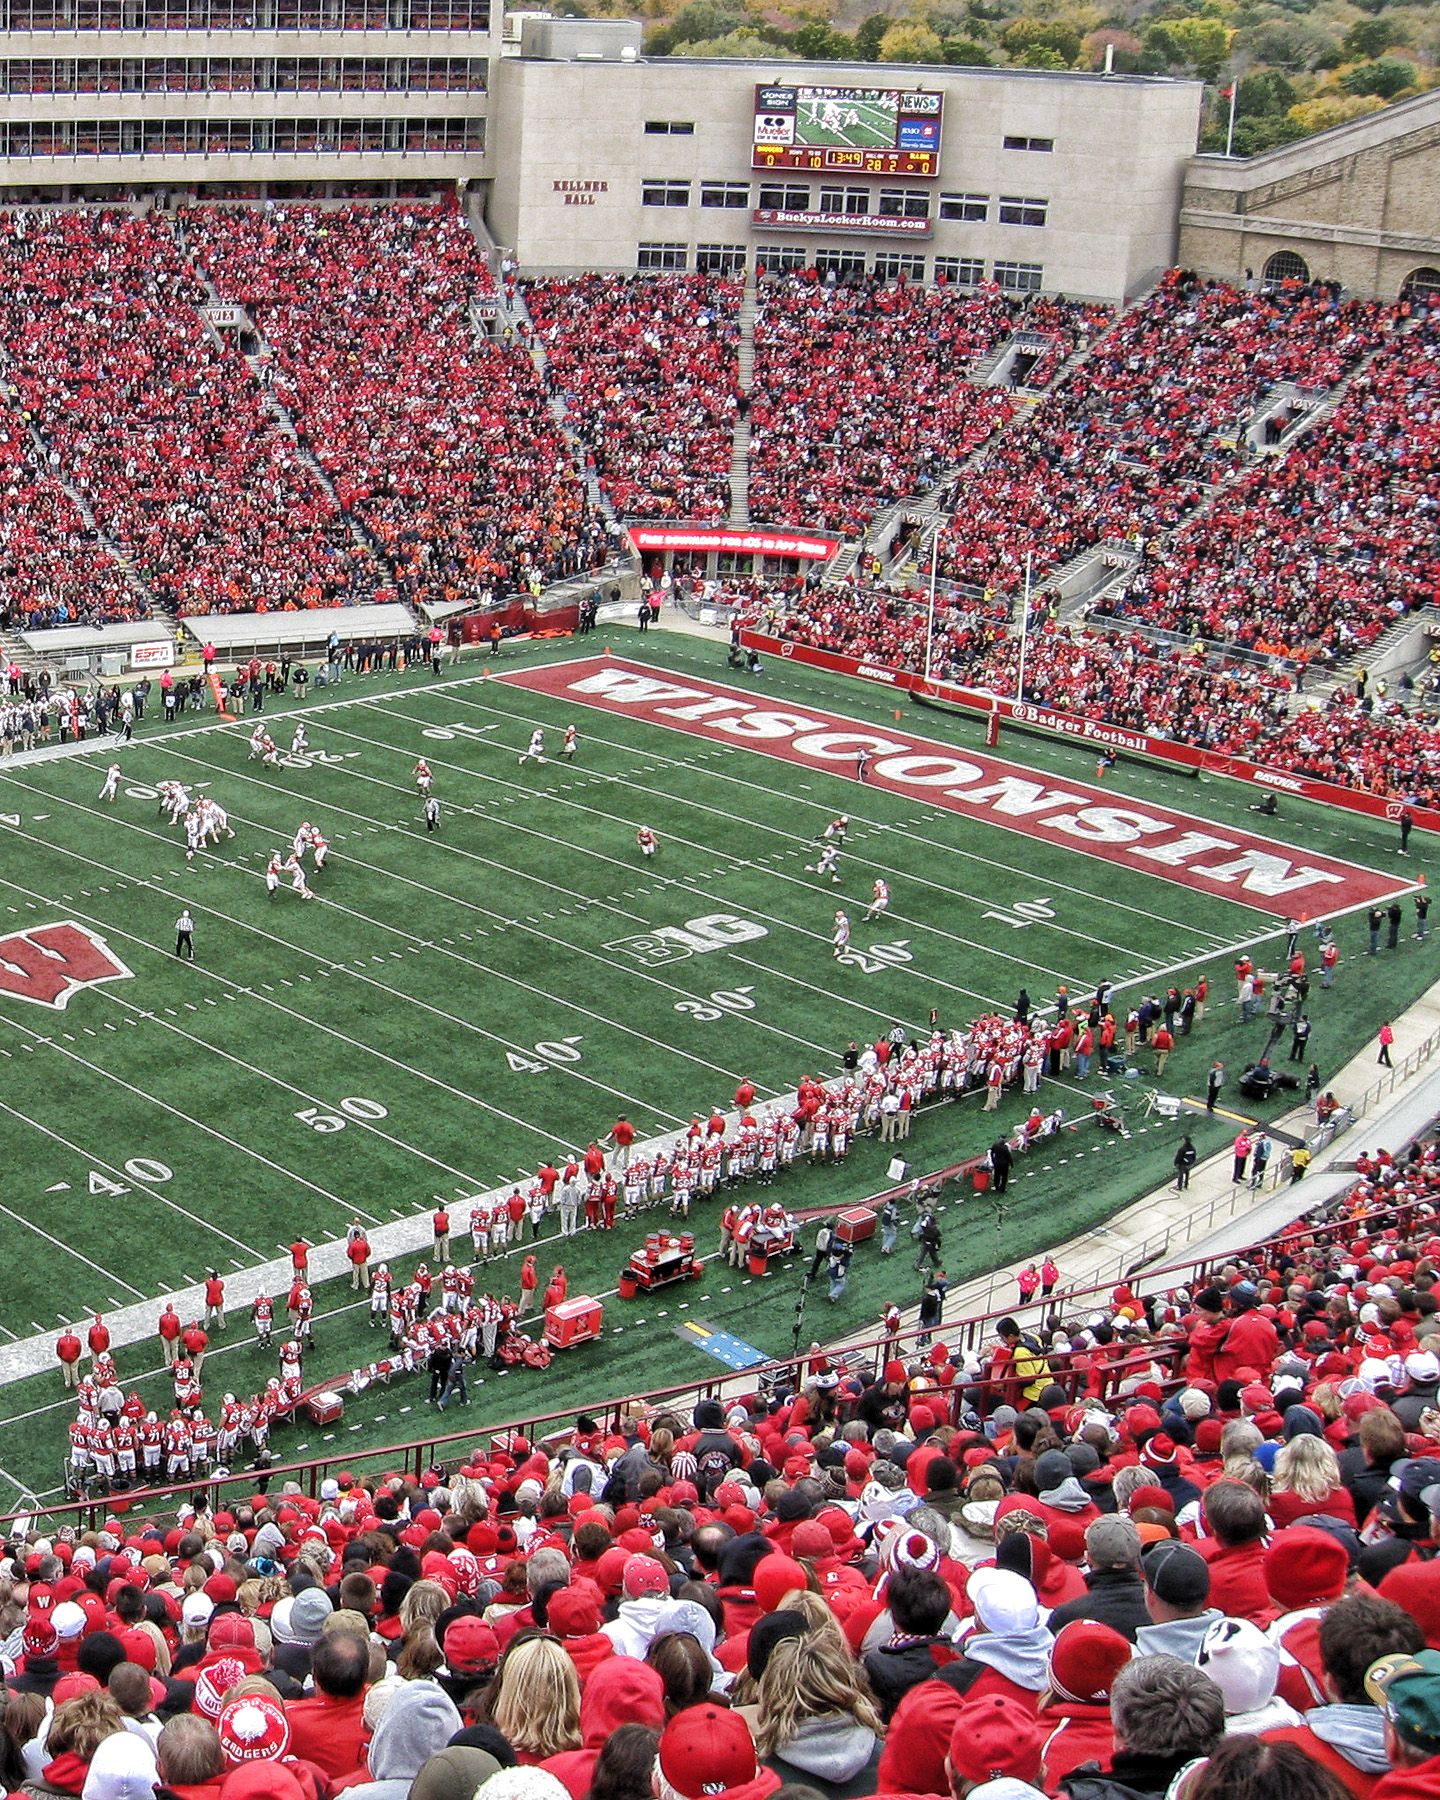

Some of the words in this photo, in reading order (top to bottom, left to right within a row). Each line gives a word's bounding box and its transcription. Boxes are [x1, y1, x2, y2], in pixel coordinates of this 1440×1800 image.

[900, 95, 929, 109] NEWS
[767, 154, 774, 166] 0
[795, 156, 799, 166] 1
[810, 157, 821, 168] 10
[832, 152, 861, 164] 13:49
[867, 160, 881, 171] 28
[889, 160, 897, 172] 2
[922, 163, 929, 173] 0
[553, 180, 608, 192] KELLNER
[564, 194, 595, 205] HALL
[777, 212, 926, 229] BuckysLockerRoom.com
[135, 647, 168, 658] ESPN
[422, 722, 486, 739] 10
[566, 667, 1345, 897] WISCONSIN
[981, 900, 1057, 928] 10
[836, 942, 914, 974] 20
[673, 988, 757, 1021] 30
[504, 1039, 582, 1073] 40
[293, 1096, 389, 1132] 50
[88, 1157, 174, 1196] 40
[177, 1368, 189, 1379] 28
[36, 1595, 50, 1609] W
[221, 1737, 278, 1759] BADGERS
